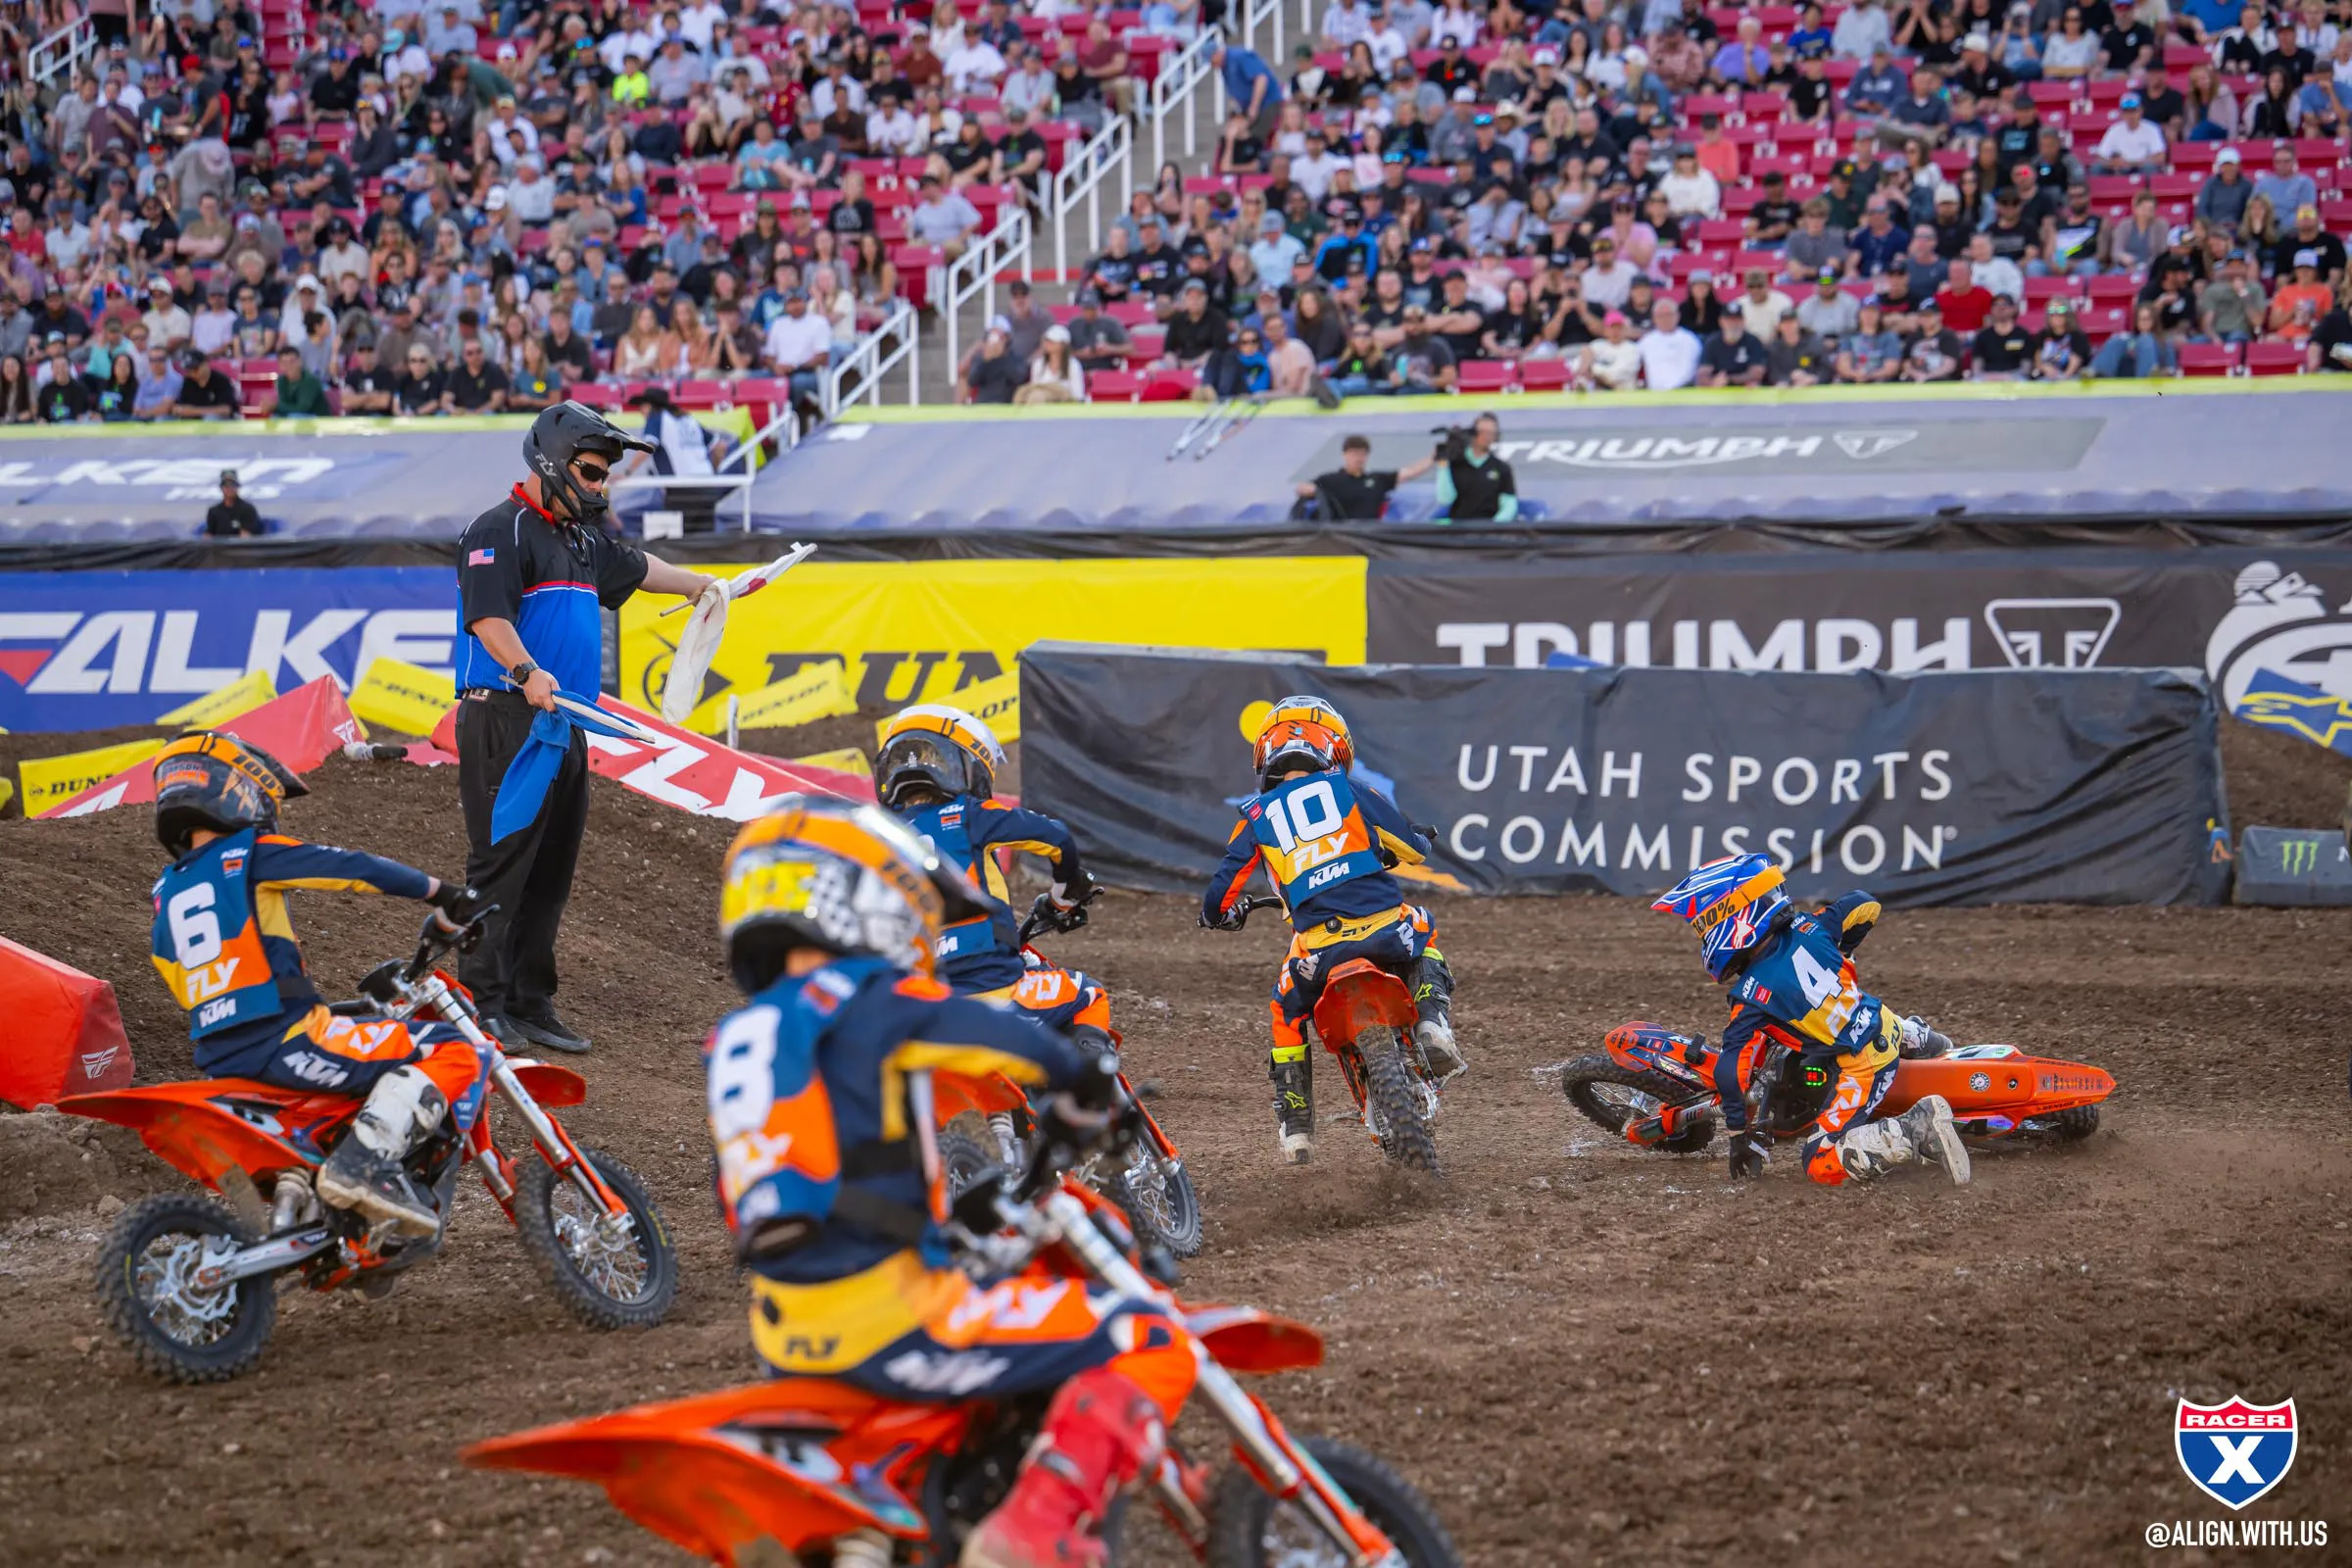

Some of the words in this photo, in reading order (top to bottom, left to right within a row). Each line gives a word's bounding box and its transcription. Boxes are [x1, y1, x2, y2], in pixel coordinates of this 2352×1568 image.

[0, 609, 459, 694] FALKE
[1457, 744, 1642, 798] UTAH
[1682, 750, 1952, 807] SPORTS
[1264, 780, 1344, 857] 10
[1293, 831, 1349, 875] FLY
[1308, 861, 1350, 890] KTM
[167, 881, 222, 971] 6
[1691, 899, 1737, 936] 100%
[186, 956, 241, 1004] FLY
[1018, 969, 1061, 1002] FLY
[1790, 944, 1844, 1011] 4
[199, 997, 237, 1029] KTM
[1848, 1005, 1874, 1045] KTM
[281, 1050, 350, 1089] KTM
[707, 1004, 783, 1143] 8
[785, 1333, 842, 1359] FLY
